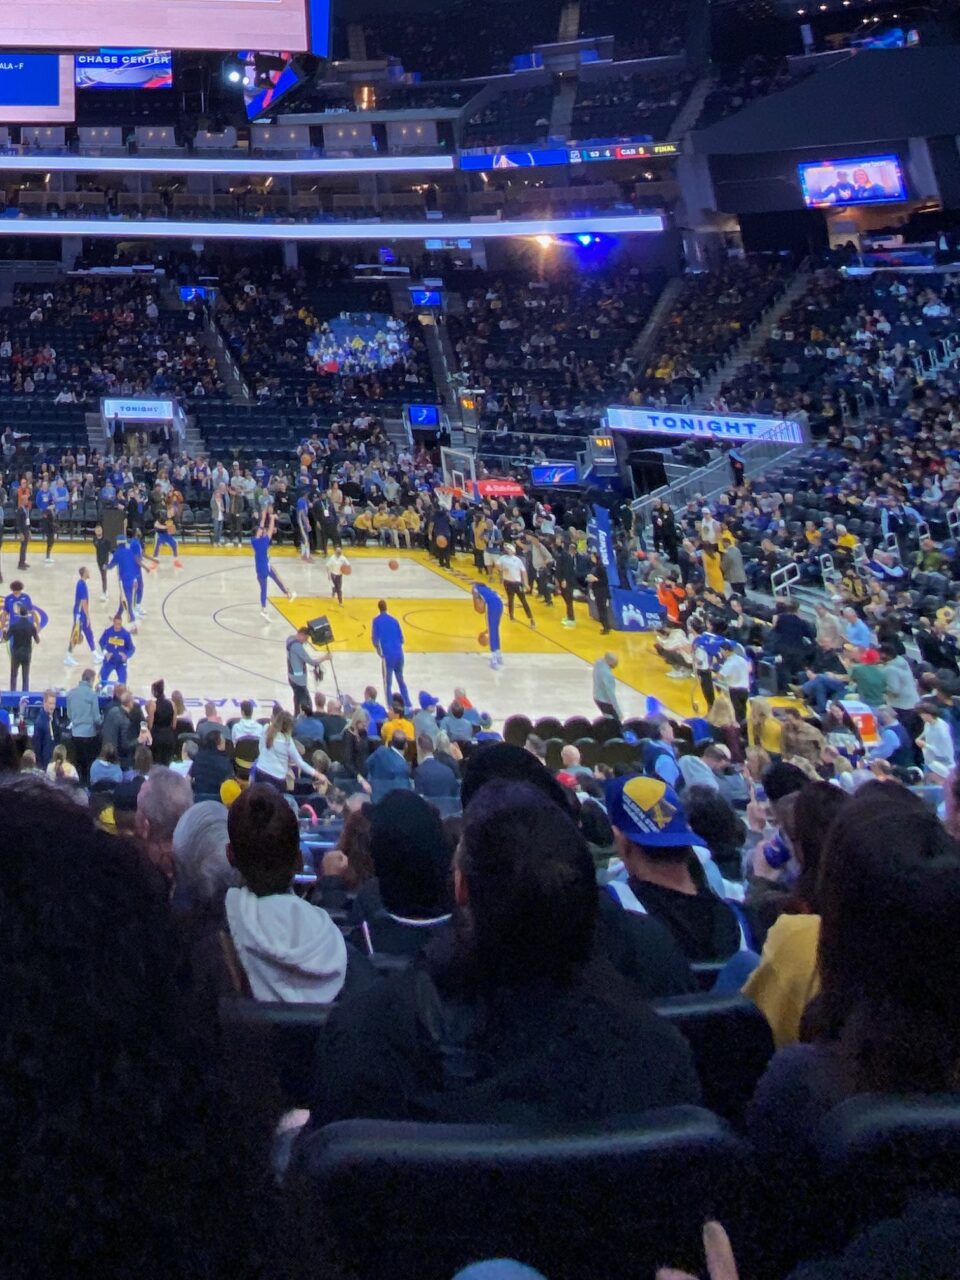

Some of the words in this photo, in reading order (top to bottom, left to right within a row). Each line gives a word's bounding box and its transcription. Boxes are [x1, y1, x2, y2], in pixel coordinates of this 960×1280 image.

[78, 55, 118, 63] CHASE
[122, 56, 169, 64] CENTER
[654, 145, 677, 153] FINAL
[647, 415, 757, 435] TONIGHT
